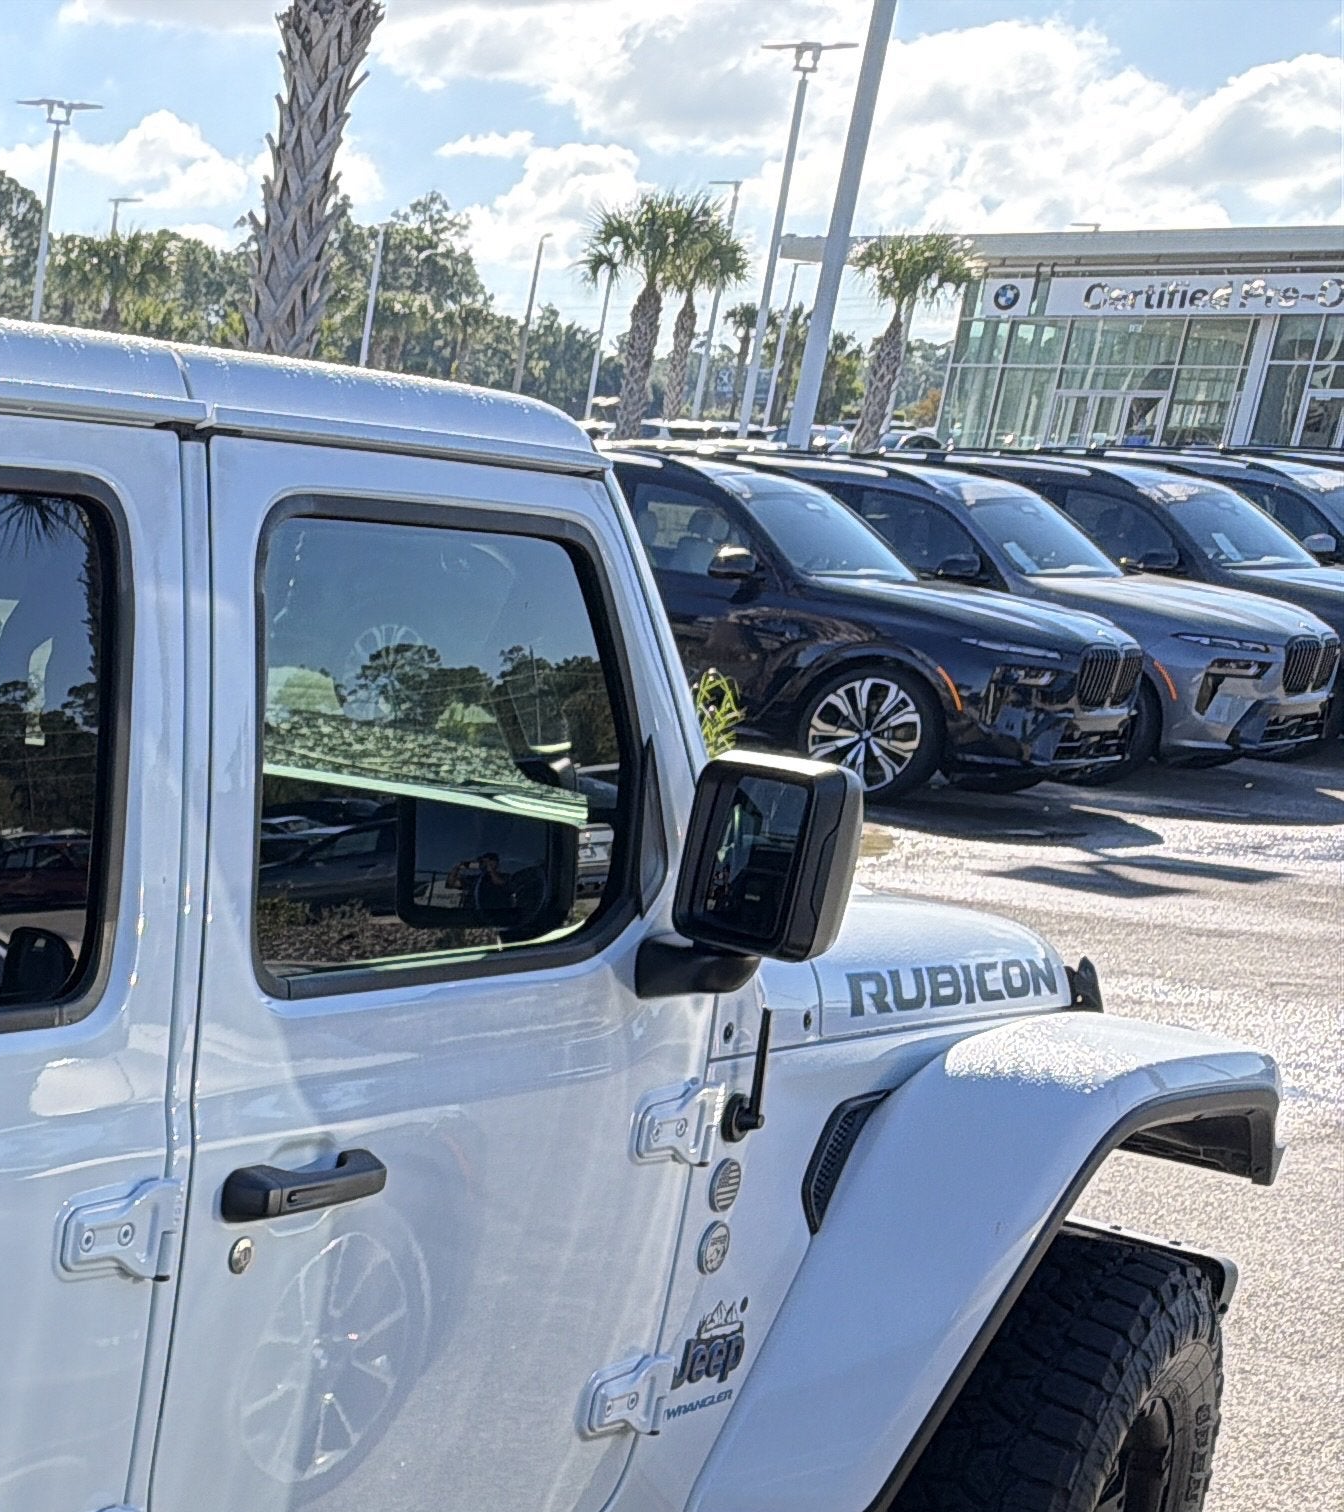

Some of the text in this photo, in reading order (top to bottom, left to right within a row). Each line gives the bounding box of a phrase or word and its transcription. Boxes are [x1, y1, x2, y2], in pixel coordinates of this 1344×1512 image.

[845, 957, 1059, 1018] RUBICON
[670, 1333, 745, 1390] Jeep
[665, 1388, 734, 1421] WRANGLER
